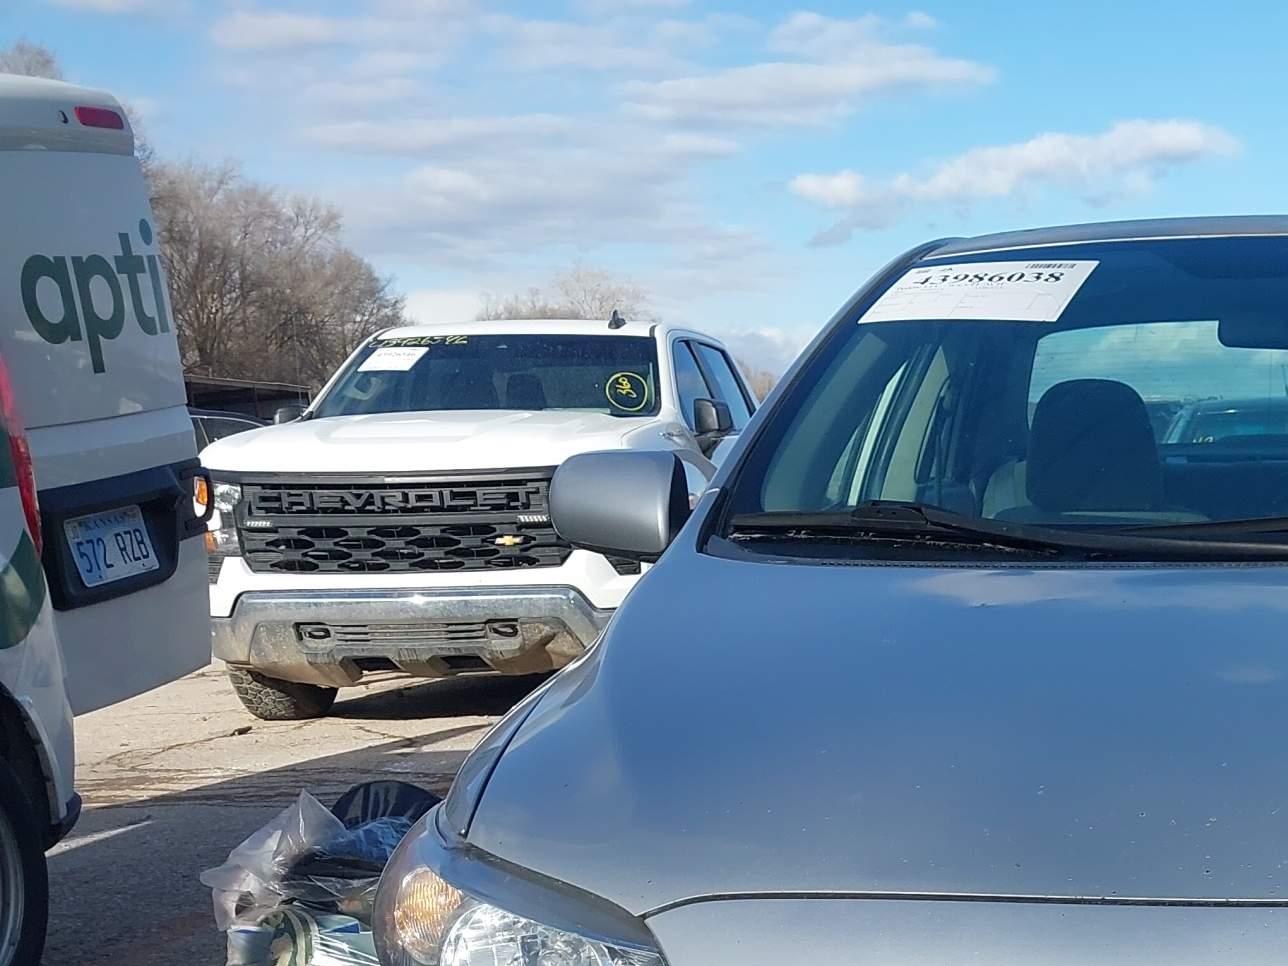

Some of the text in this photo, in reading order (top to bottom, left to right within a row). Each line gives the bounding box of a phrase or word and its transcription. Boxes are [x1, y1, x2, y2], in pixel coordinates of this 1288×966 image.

[913, 271, 1065, 285] 43986038
[252, 487, 540, 513] CHEVROLET
[76, 528, 150, 574] 572 RZB
